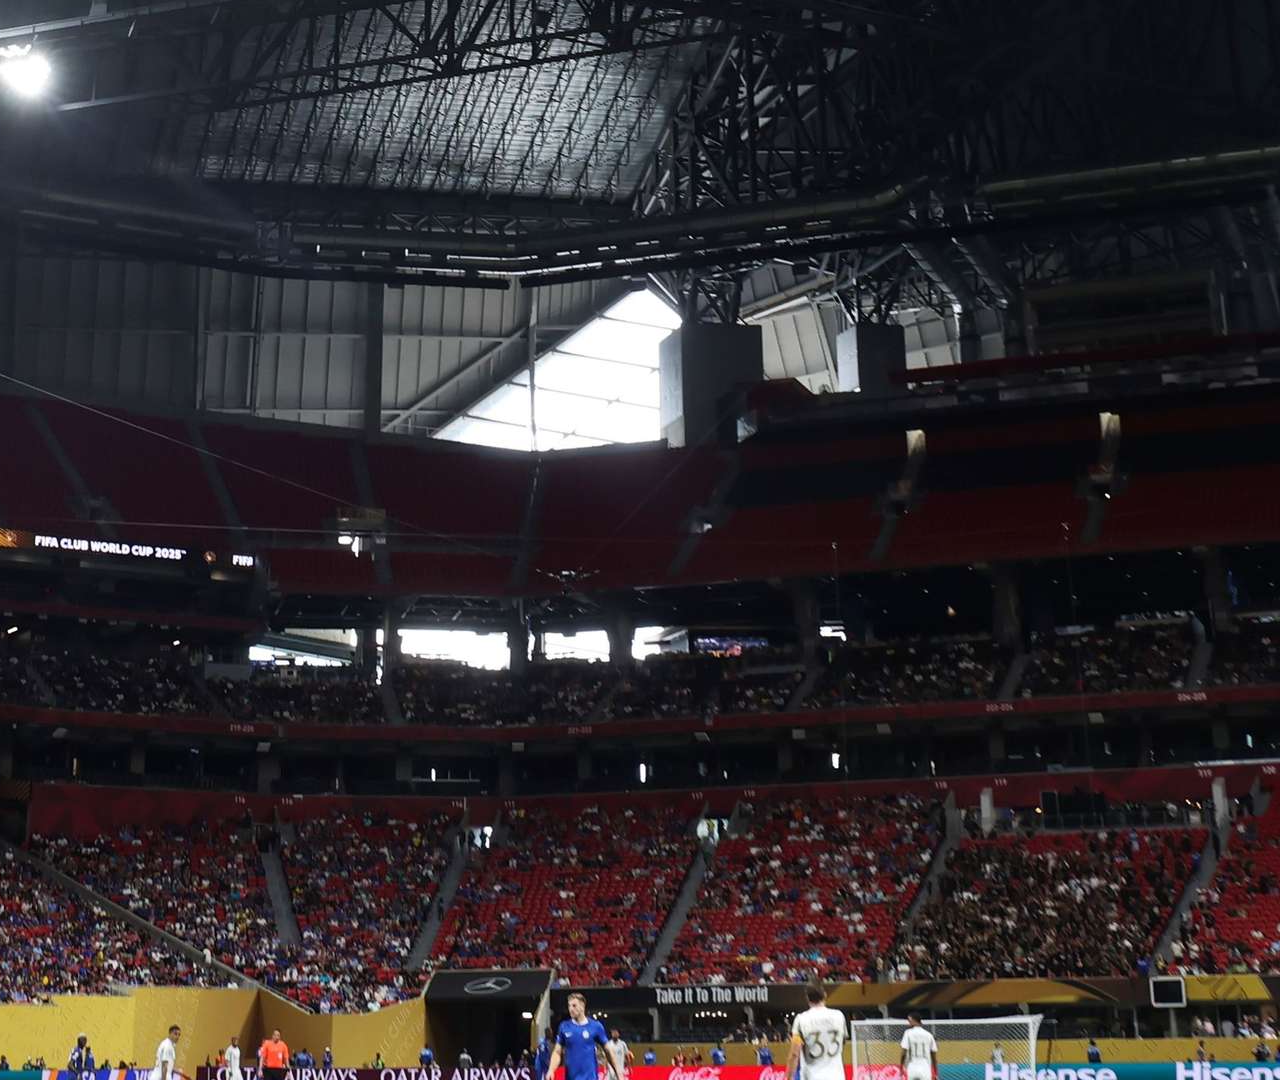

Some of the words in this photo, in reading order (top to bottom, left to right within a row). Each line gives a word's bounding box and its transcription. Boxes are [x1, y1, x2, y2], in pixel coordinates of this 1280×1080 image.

[35, 535, 59, 549] FIFA
[60, 538, 89, 551] CLUB
[90, 541, 130, 555] WORLD
[132, 545, 154, 557] CUP
[655, 986, 683, 1004] Take
[696, 986, 709, 1003] To
[710, 986, 731, 1003] The
[733, 985, 768, 1003] World
[808, 1031, 839, 1059] 33
[984, 1061, 1117, 1080] Hisense
